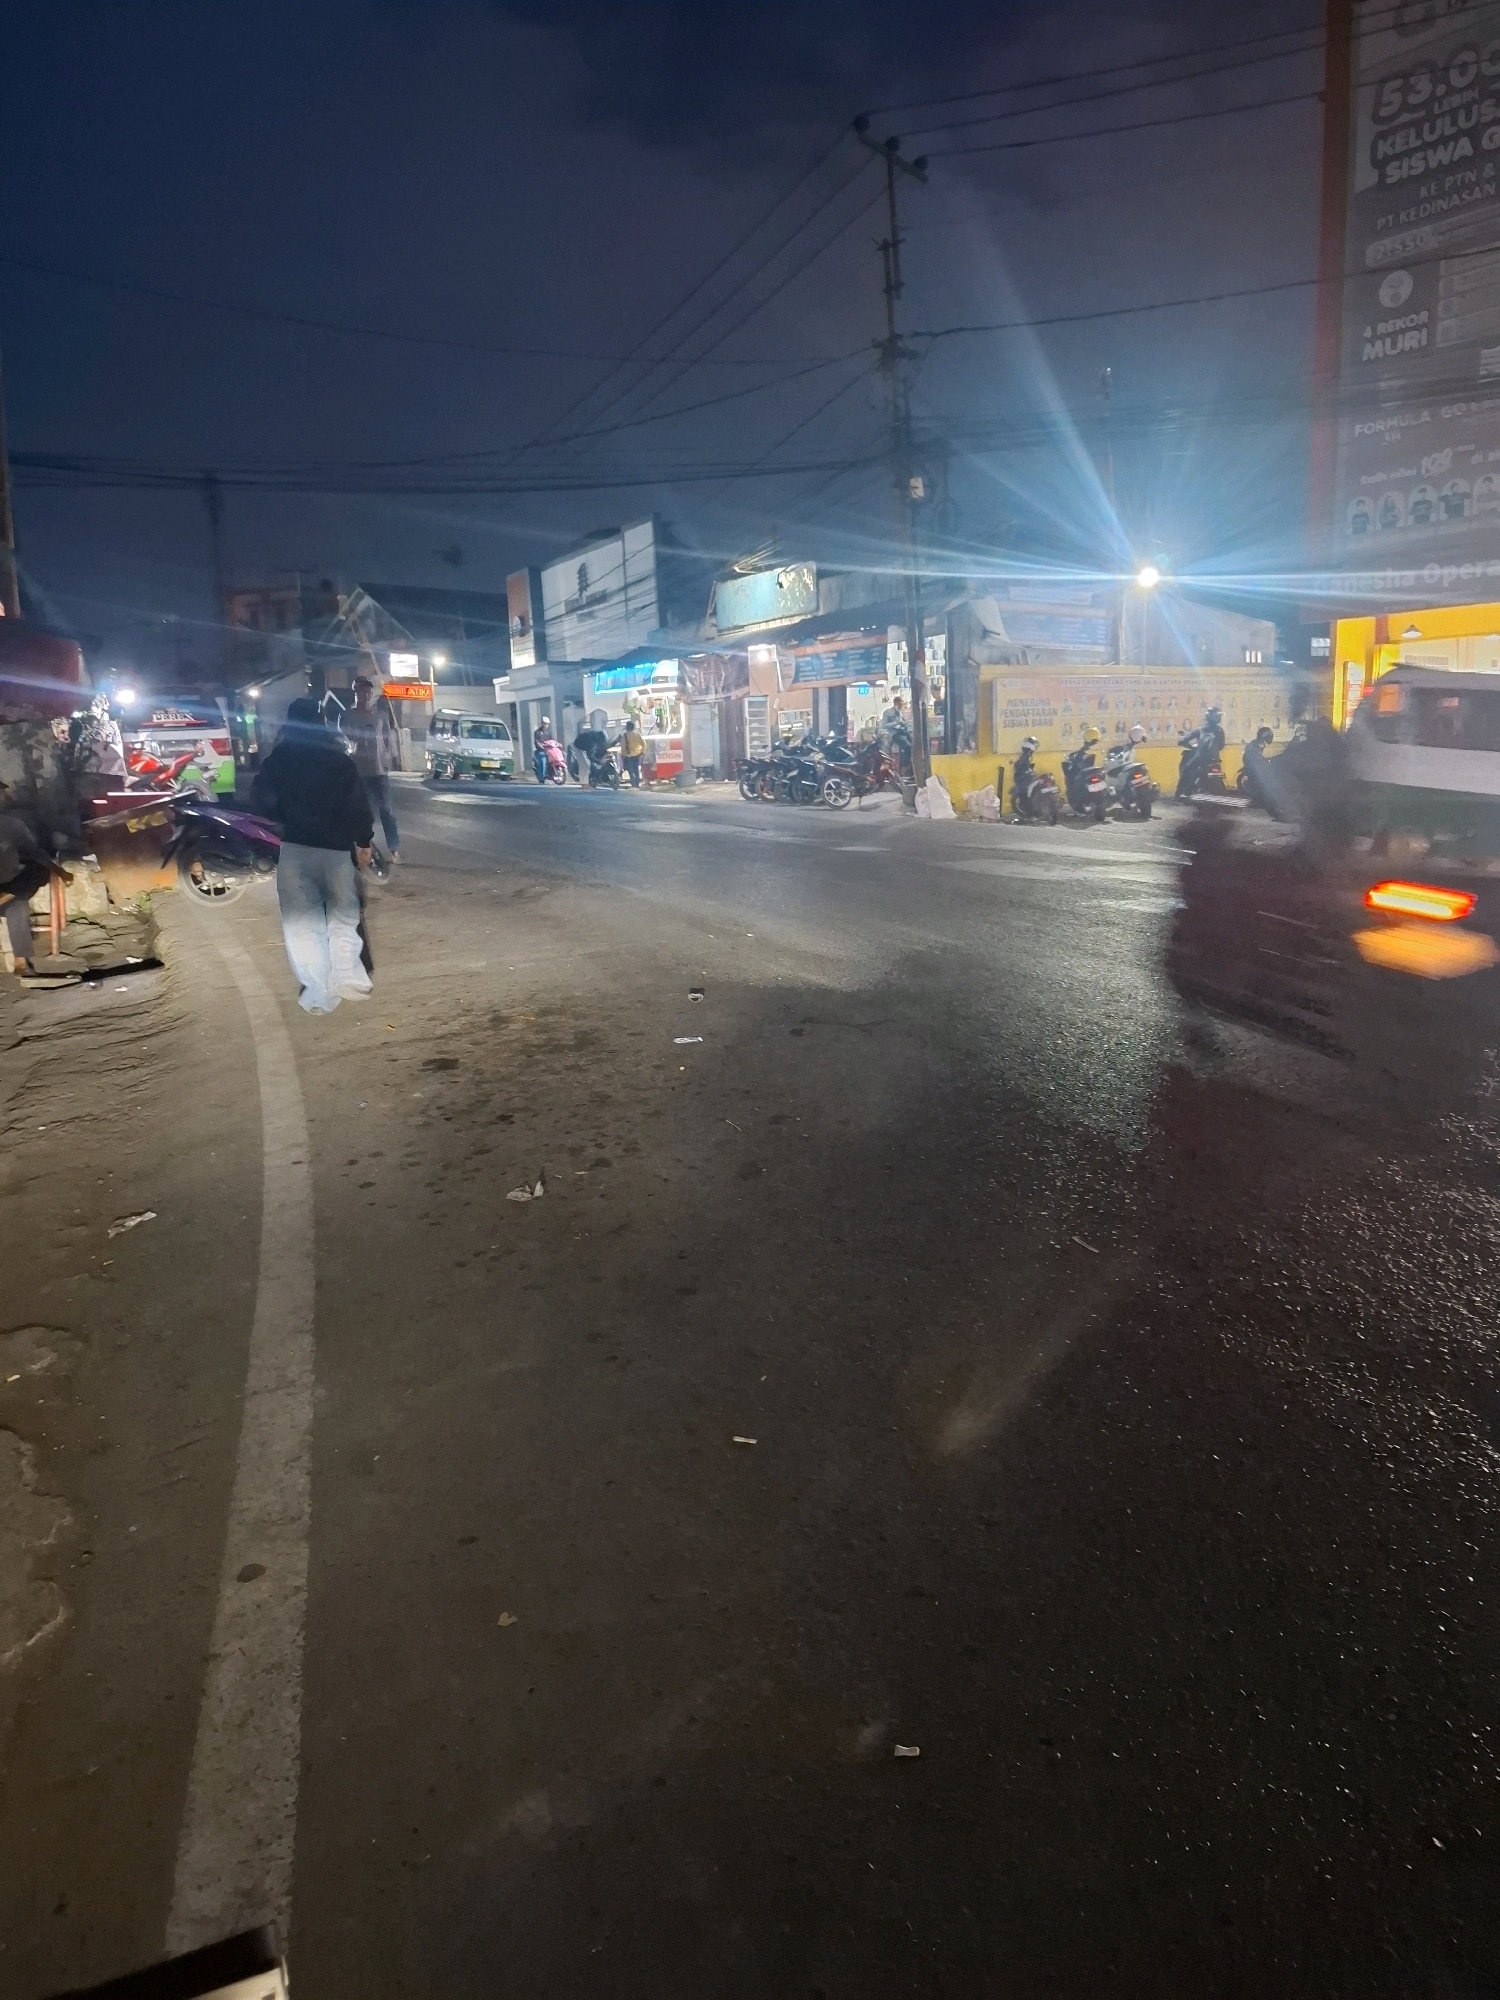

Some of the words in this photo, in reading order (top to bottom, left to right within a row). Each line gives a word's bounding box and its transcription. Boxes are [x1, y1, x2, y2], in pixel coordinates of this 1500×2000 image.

[1377, 98, 1500, 160] KELULUS
[1386, 137, 1474, 184] SISWA
[1420, 181, 1440, 199] KE
[1444, 169, 1477, 192] PTN
[1377, 214, 1395, 231] PT
[1400, 182, 1496, 224] KEDINASAN
[1377, 310, 1429, 336] REKOR
[1362, 328, 1428, 361] MURI
[1354, 410, 1431, 437] FORMULA
[1000, 708, 1058, 718] PENDAFTARAN
[1007, 698, 1051, 707] MENERIMA
[1003, 719, 1031, 728] SISWA
[1032, 718, 1054, 727] BARU
